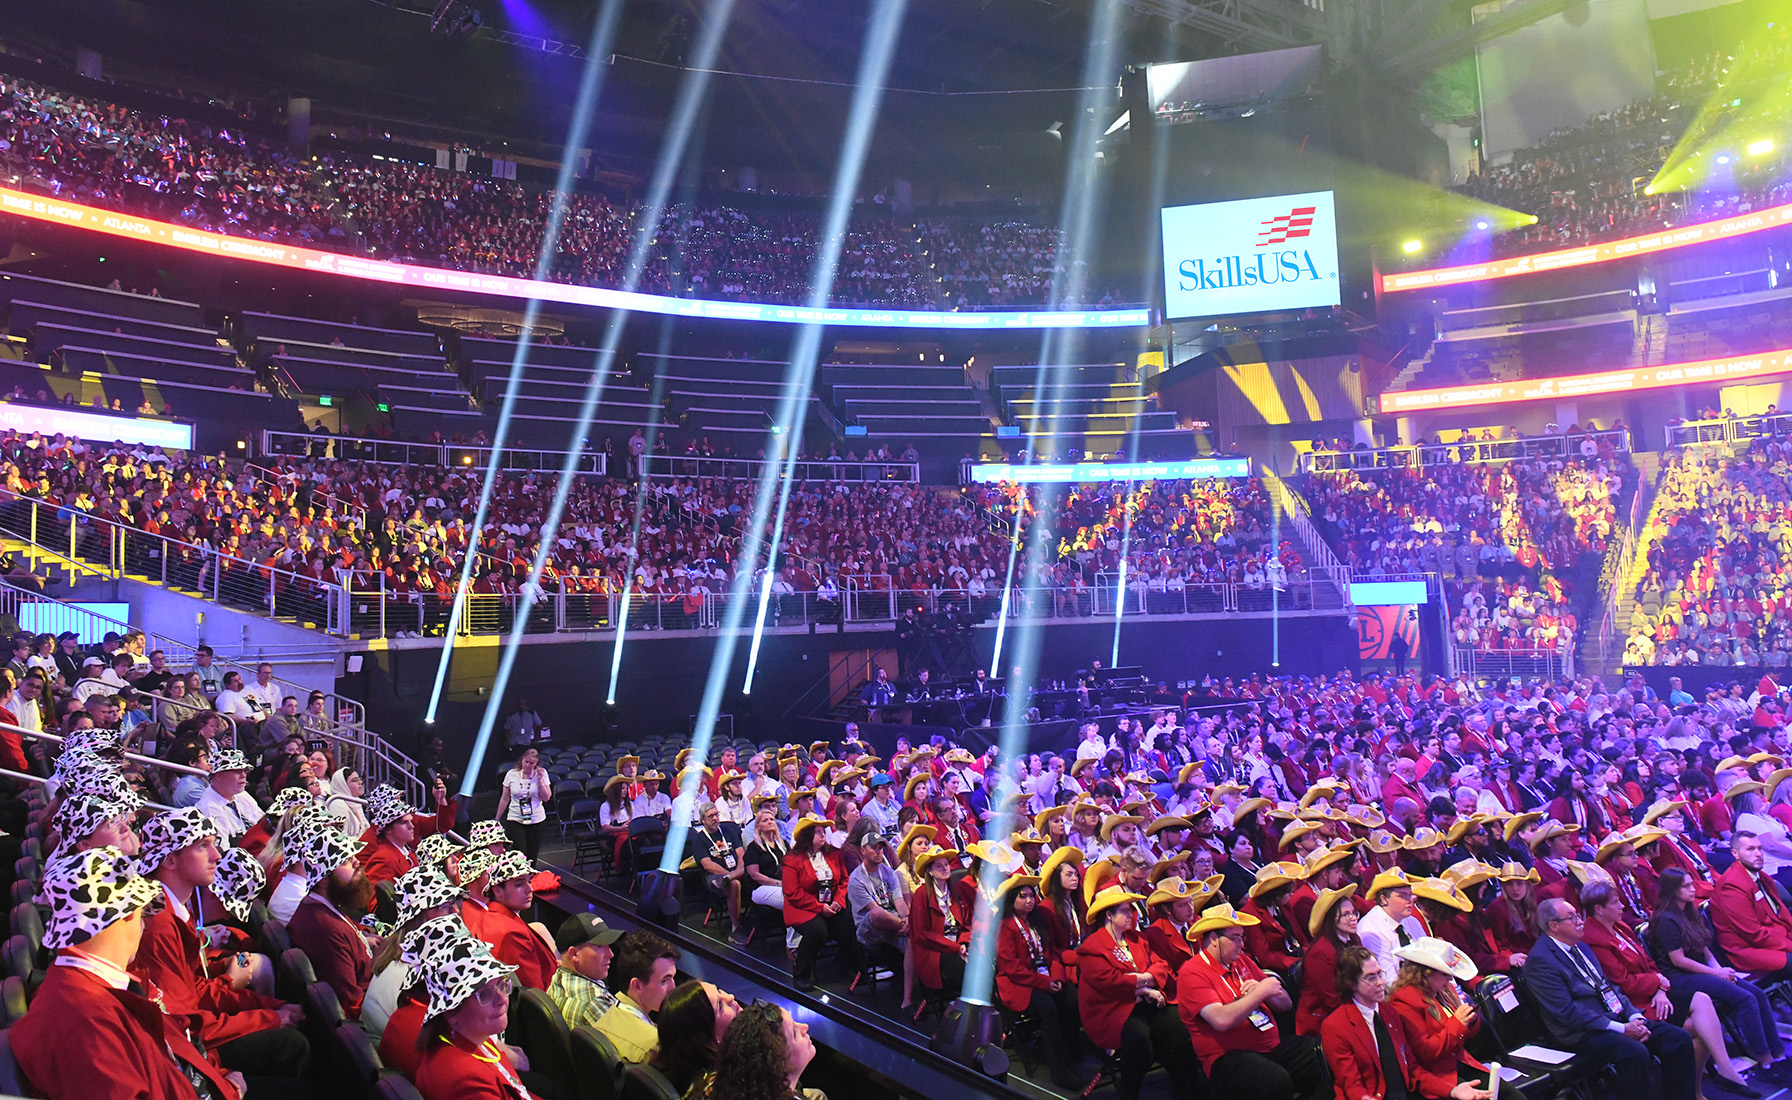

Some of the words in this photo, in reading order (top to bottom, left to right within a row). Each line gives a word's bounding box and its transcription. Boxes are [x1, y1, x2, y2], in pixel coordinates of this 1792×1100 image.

[34, 201, 47, 213] IS
[47, 204, 84, 220] NOW
[102, 217, 152, 235] ATLANTA
[1719, 217, 1764, 233] ATLANTA
[1615, 241, 1638, 253] OUR
[1673, 229, 1703, 243] NOW
[220, 240, 286, 260] CEREMONY
[1179, 249, 1322, 292] SkillsUSA
[423, 272, 447, 284] OUR
[481, 280, 508, 290] NOW
[776, 309, 795, 319] OUR
[824, 312, 848, 321] NOW
[860, 313, 894, 322] ATLANTA
[1655, 369, 1684, 380] OUR
[1684, 366, 1714, 378] TIME
[1714, 364, 1727, 374] IS
[1727, 359, 1763, 373] NOW
[1440, 388, 1503, 402] CEREMONY
[1089, 469, 1110, 477] OUR
[1110, 468, 1131, 477] TIME
[1131, 468, 1141, 476] IS
[1141, 467, 1168, 476] NOW
[1183, 464, 1221, 474] ATLANTA
[312, 742, 322, 750] 111
